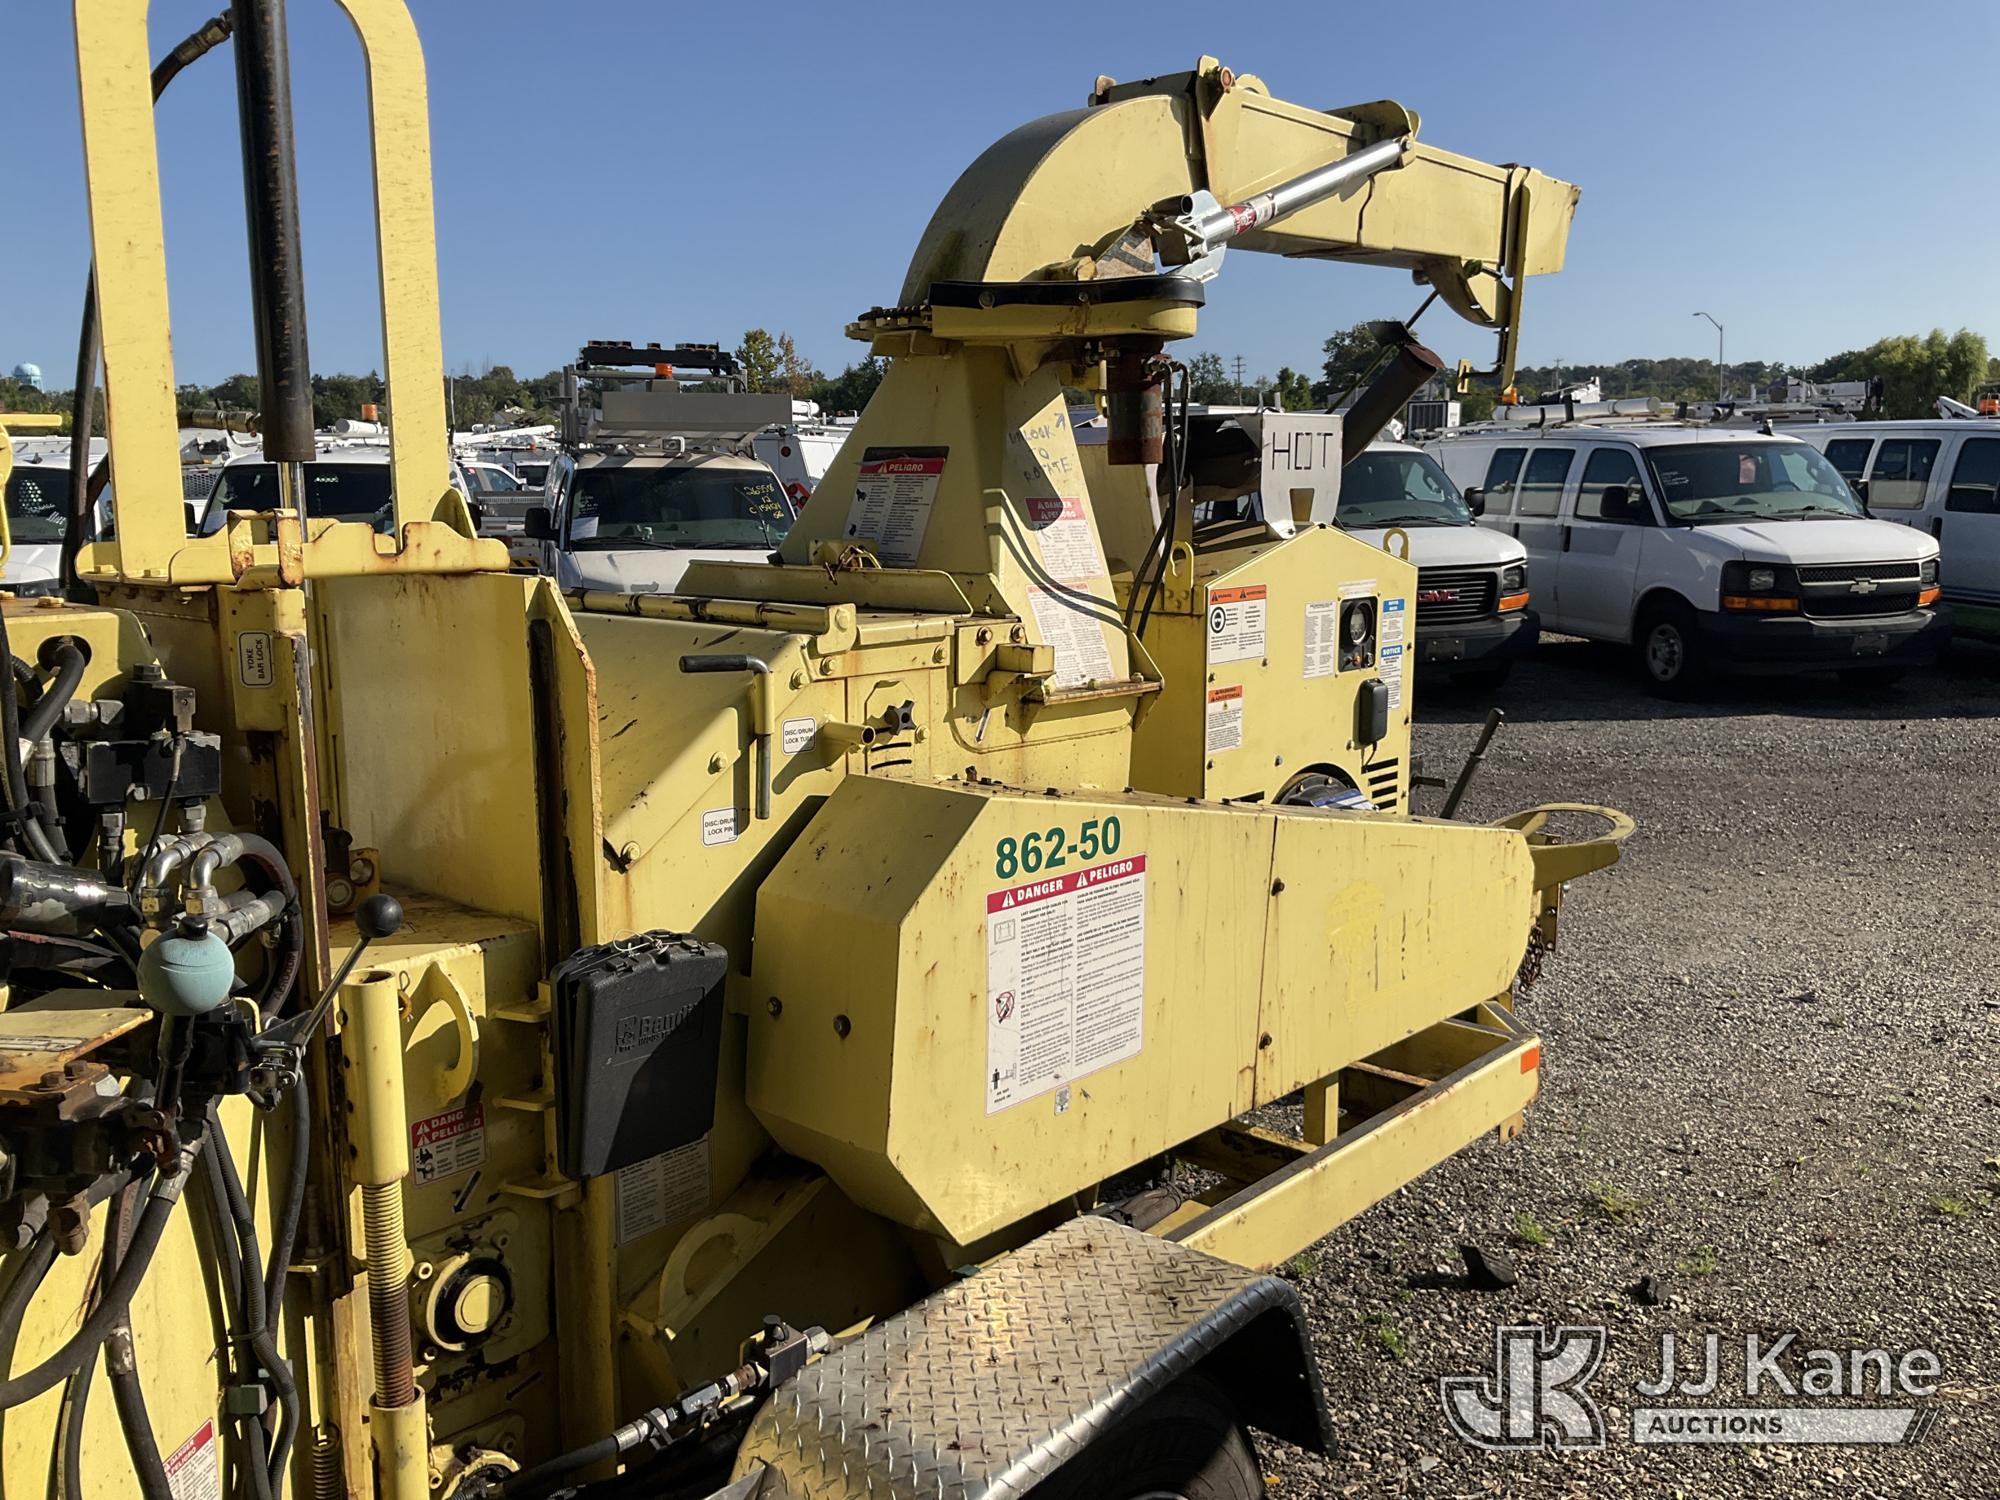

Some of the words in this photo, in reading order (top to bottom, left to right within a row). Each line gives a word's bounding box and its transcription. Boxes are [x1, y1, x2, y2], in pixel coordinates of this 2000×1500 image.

[1272, 432, 1334, 471] HOT
[888, 463, 924, 472] PELIGRO
[246, 647, 255, 671] YOKE
[255, 639, 264, 660] LOCK
[1382, 647, 1401, 656] NOTICE
[257, 662, 265, 679] BAR
[785, 737, 799, 745] LOCK
[704, 817, 737, 828] DISC/DRUM
[708, 827, 723, 836] LOCK
[996, 815, 1121, 879] 862-50
[1017, 879, 1064, 901] DANGER
[1089, 861, 1133, 882] PELIGRO
[431, 1118, 481, 1140] PELIGO
